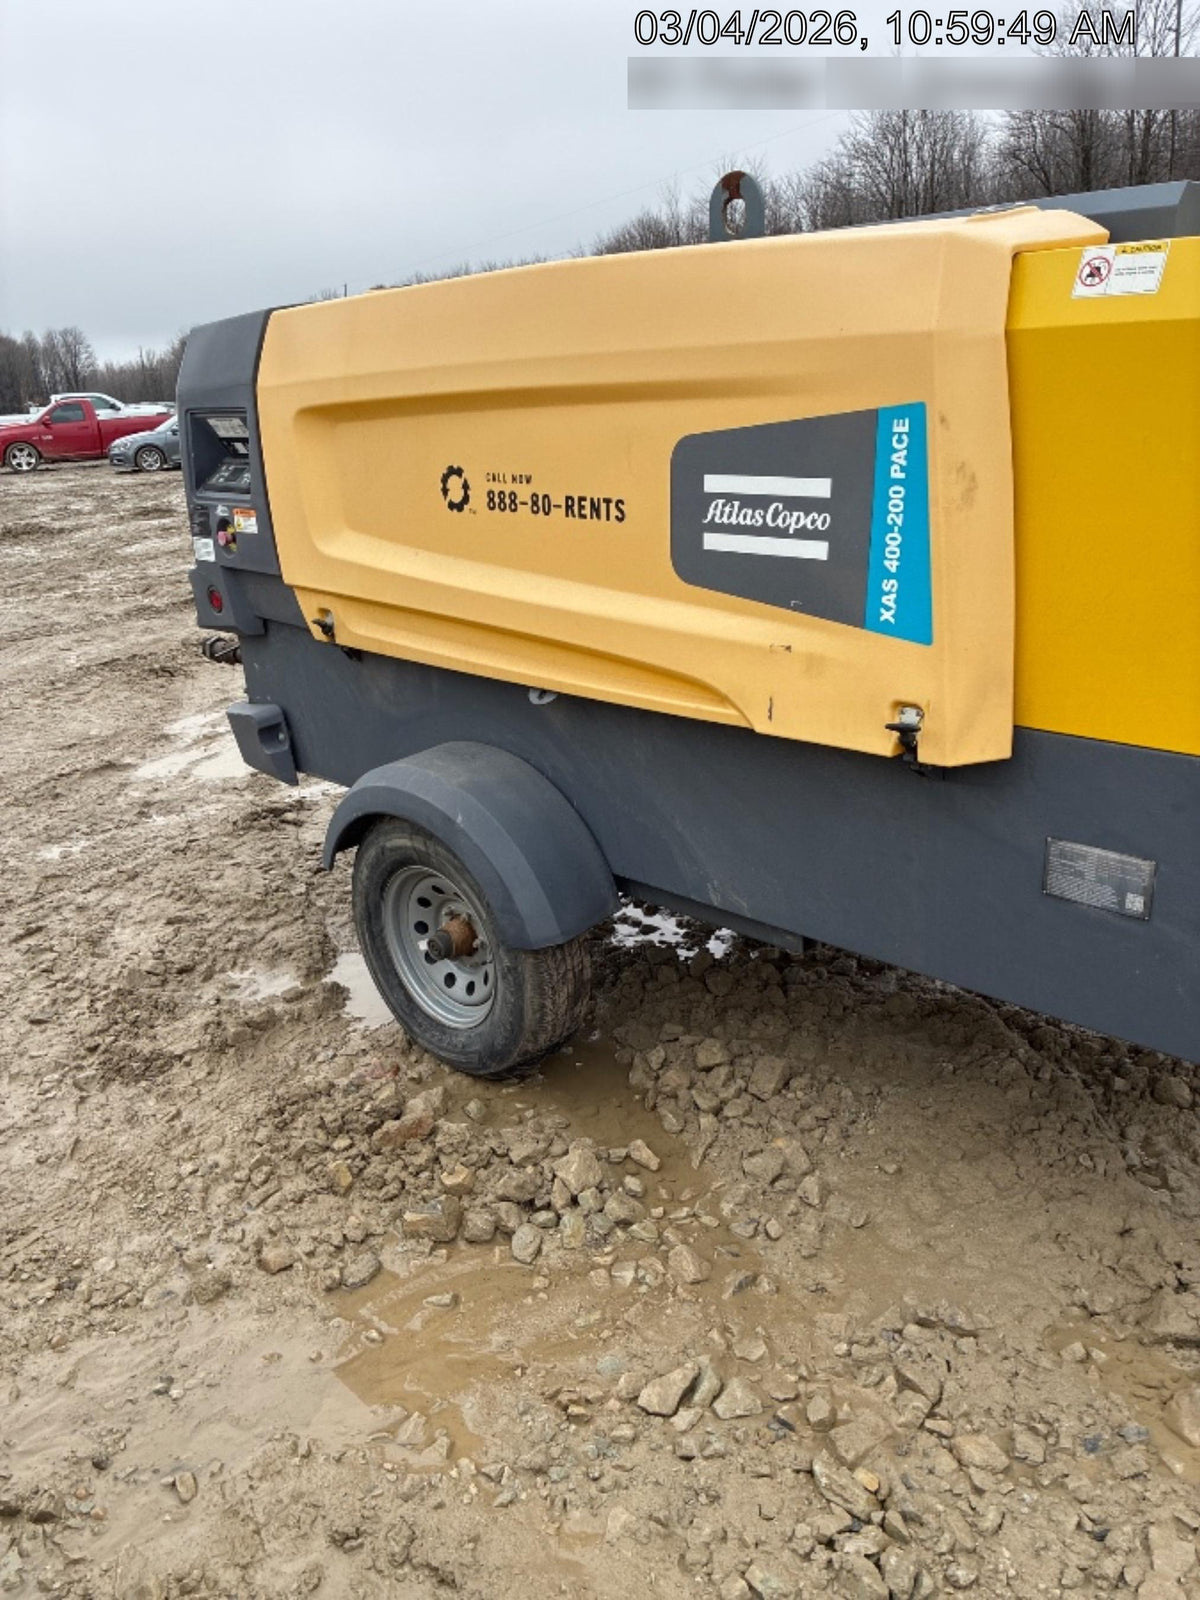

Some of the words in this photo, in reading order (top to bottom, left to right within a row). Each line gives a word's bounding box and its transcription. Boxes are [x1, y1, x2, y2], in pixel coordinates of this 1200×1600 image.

[890, 417, 909, 479] PACE
[486, 473, 507, 483] CALL
[511, 474, 532, 484] NOW
[487, 490, 625, 523] 888-80-RENTS
[883, 485, 905, 574] 400-200
[879, 579, 898, 624] XAS
